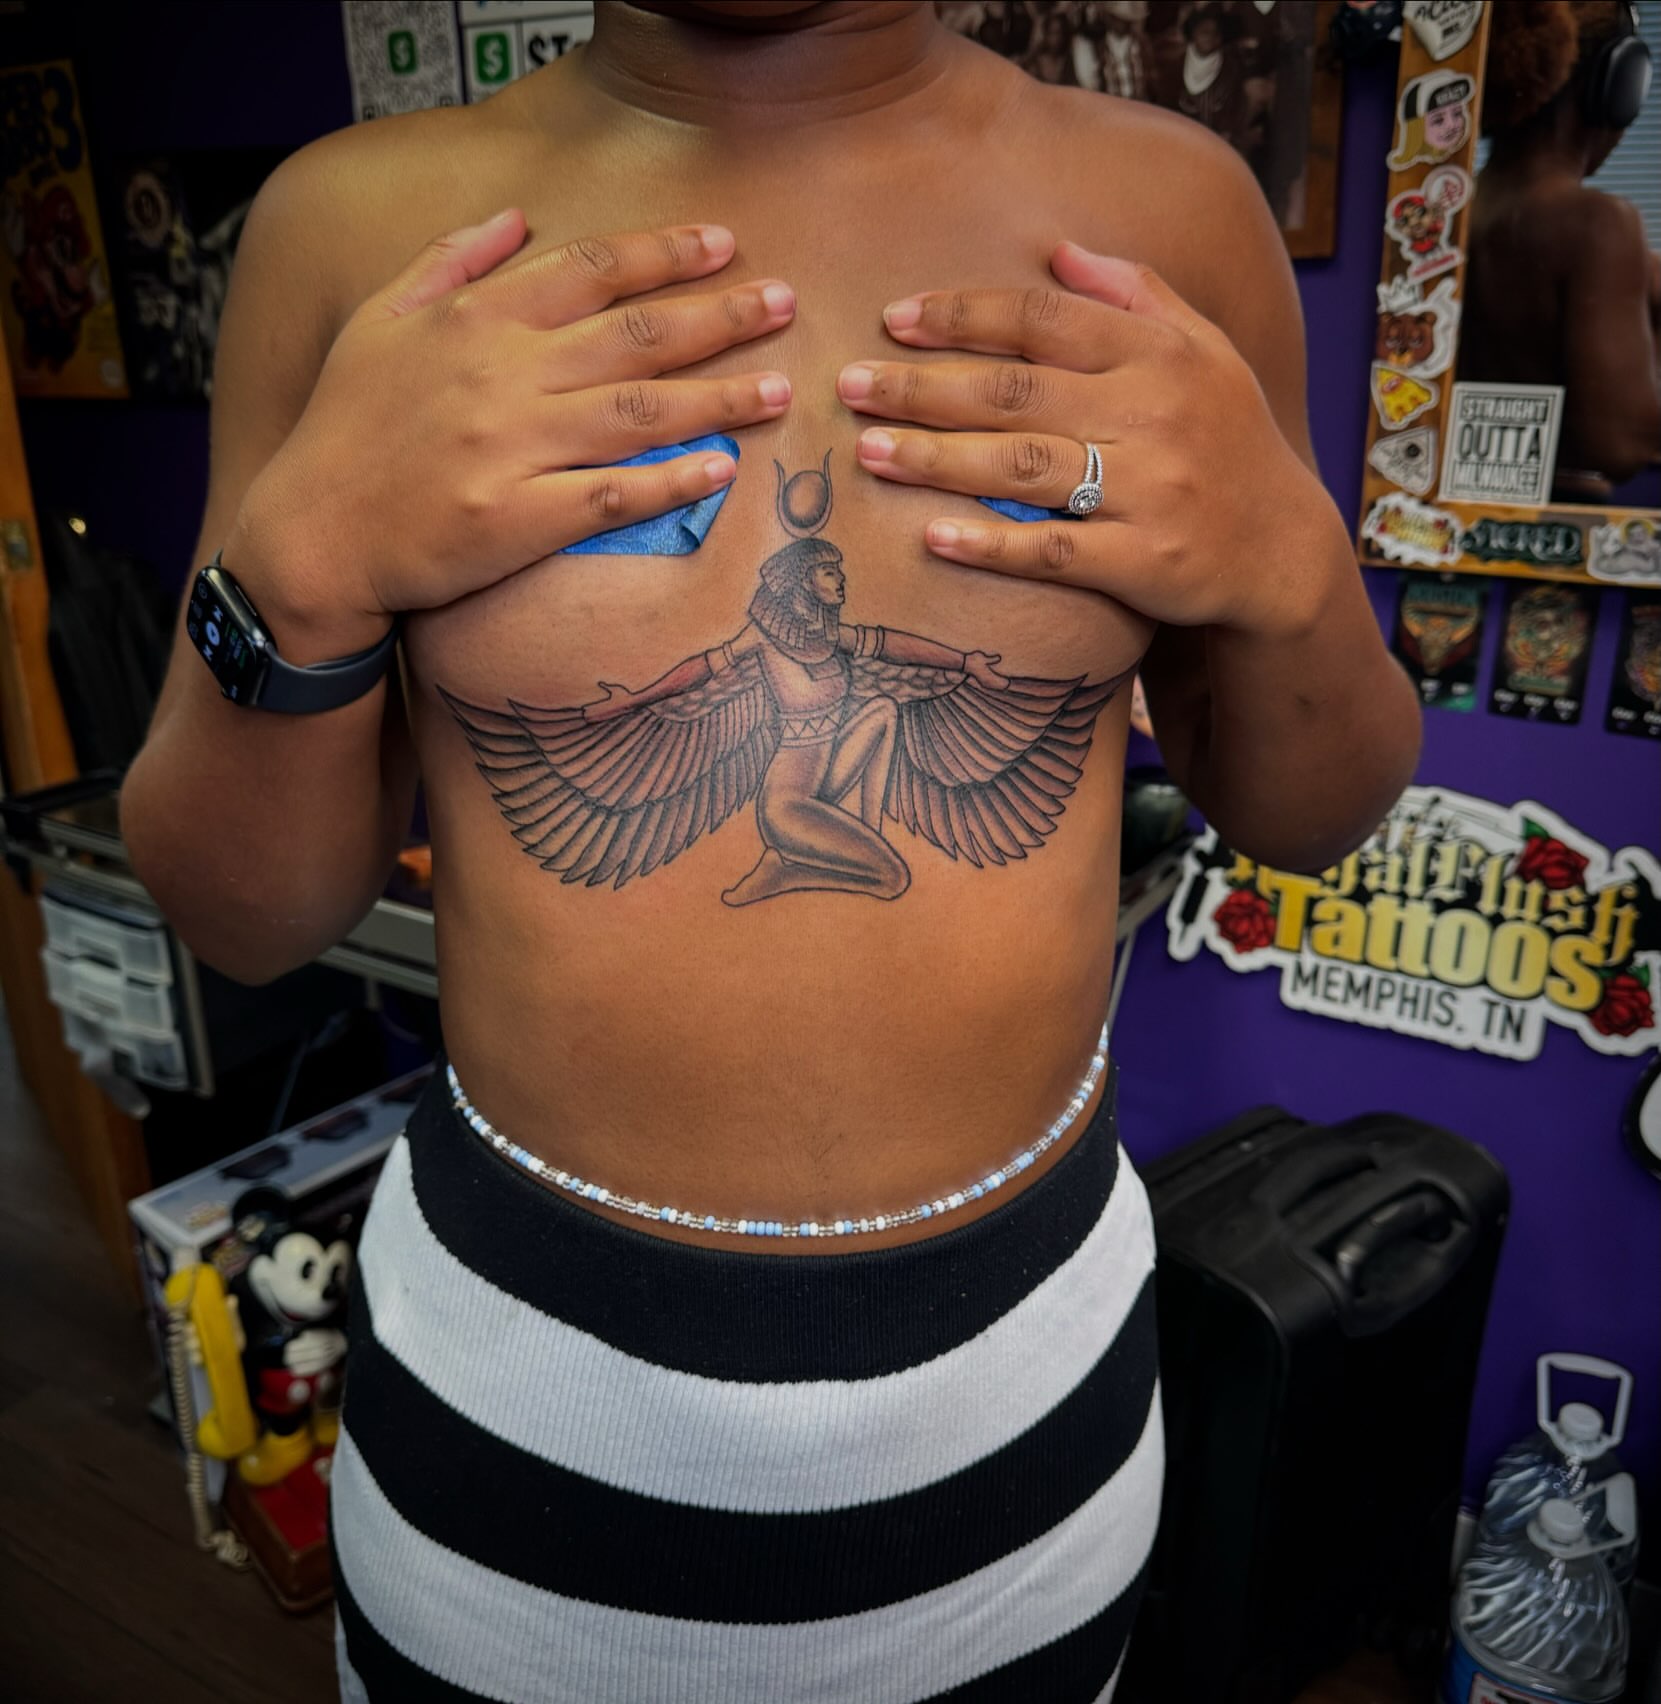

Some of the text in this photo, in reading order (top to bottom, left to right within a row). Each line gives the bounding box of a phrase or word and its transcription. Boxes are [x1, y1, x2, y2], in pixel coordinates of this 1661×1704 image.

[1461, 396, 1548, 421] STRAIGHT
[1459, 424, 1541, 460] OUTTA
[1271, 871, 1604, 1011] Tattoos
[1482, 1000, 1526, 1043] TN
